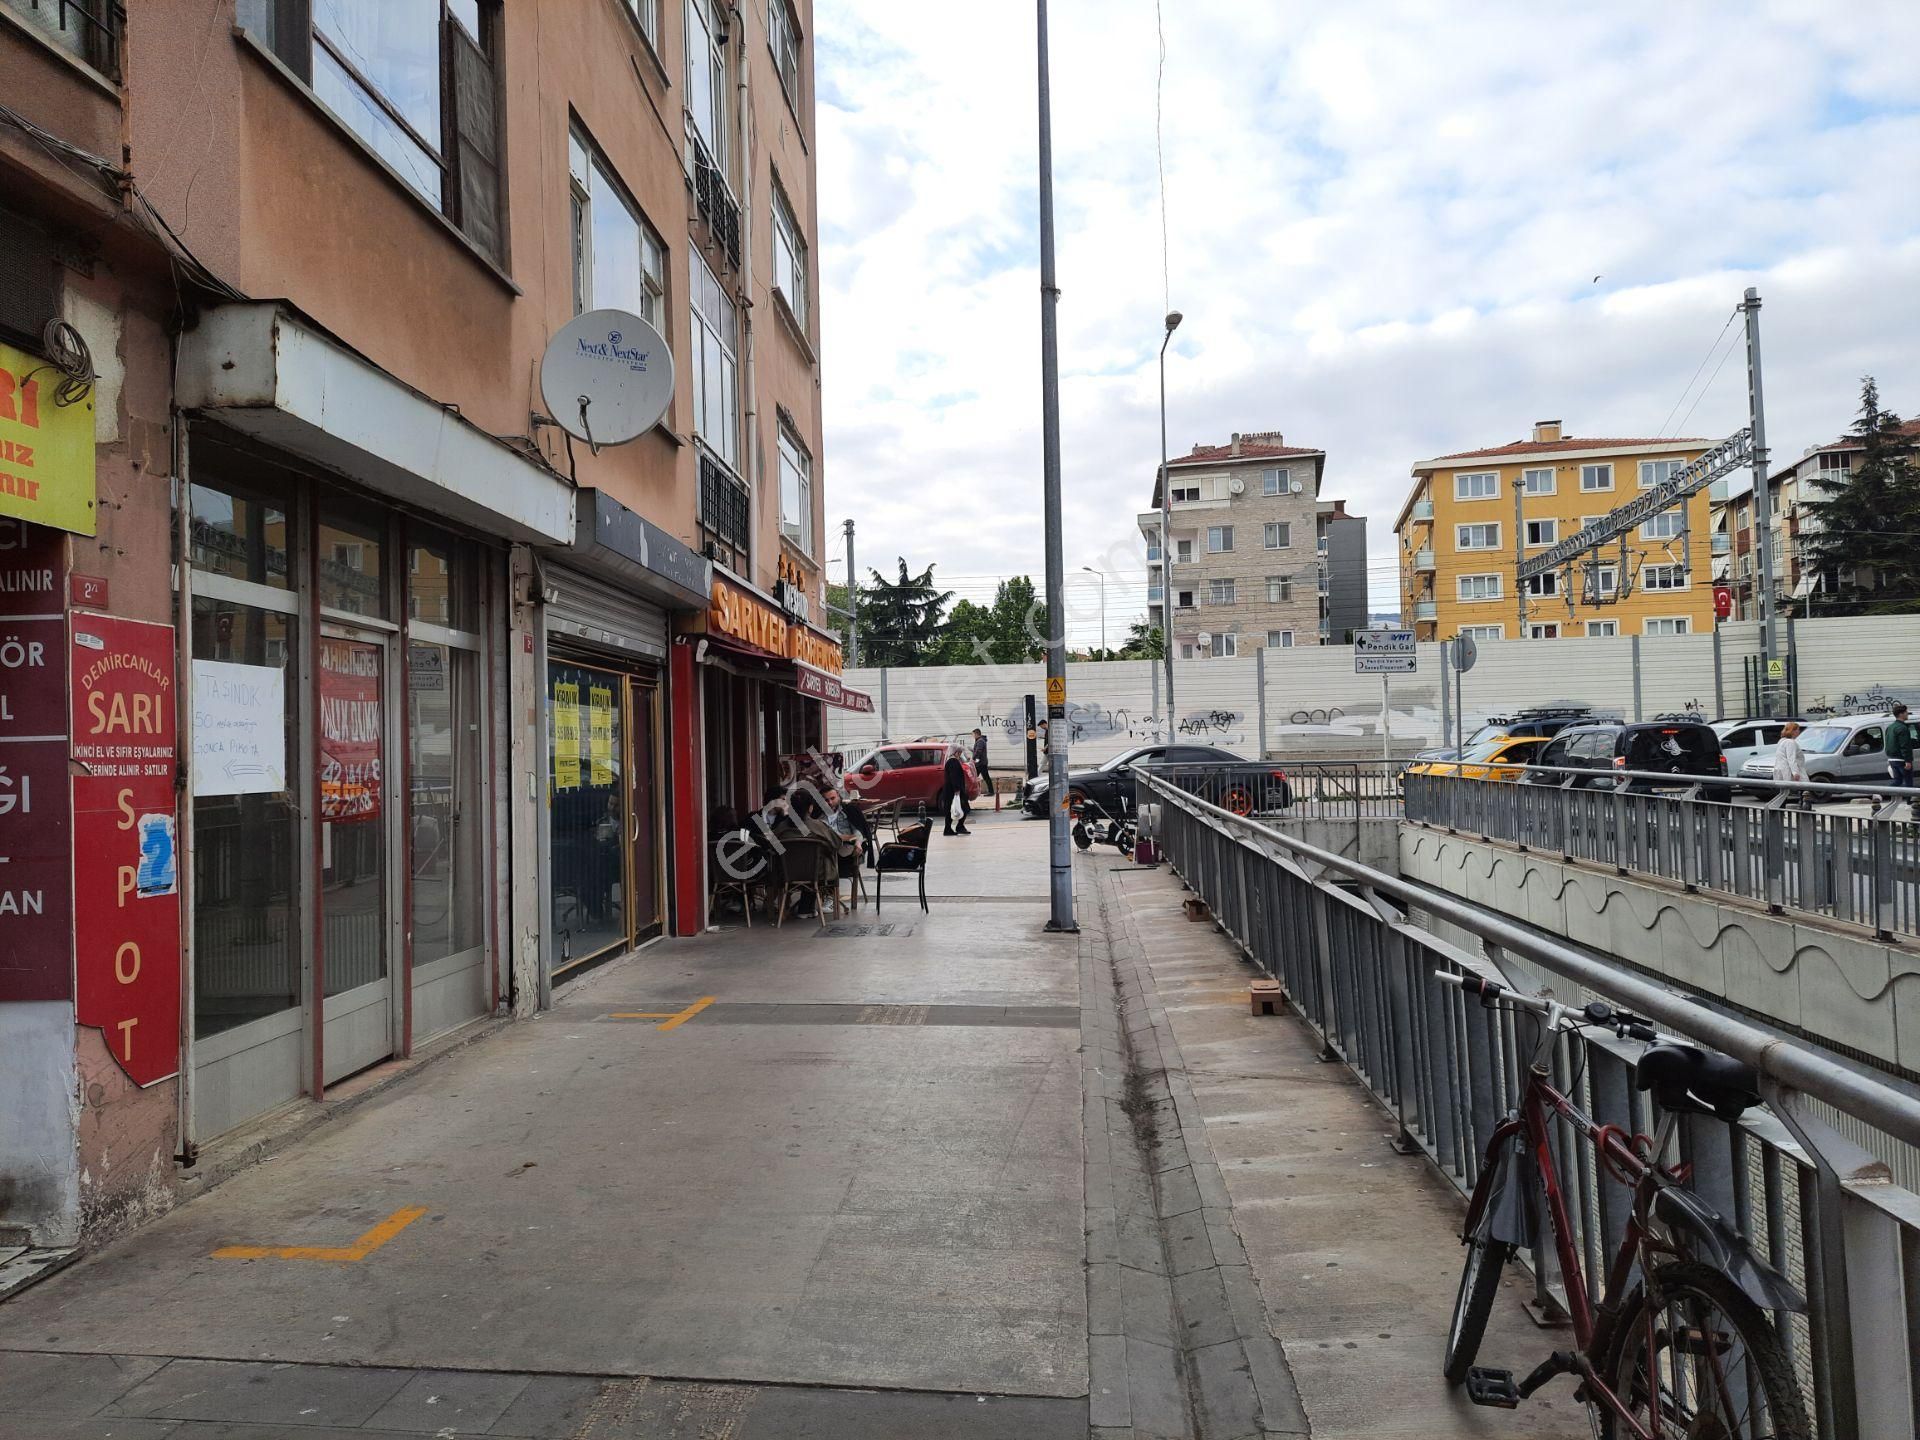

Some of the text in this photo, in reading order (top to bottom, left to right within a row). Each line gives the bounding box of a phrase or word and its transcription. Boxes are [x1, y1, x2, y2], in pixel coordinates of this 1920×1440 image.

[577, 338, 597, 357] Next
[710, 582, 788, 658] SARIYER
[1367, 642, 1414, 651] Pendik Gar
[81, 652, 170, 691] DEMİRCANLAR
[87, 690, 163, 735] SARI
[980, 715, 1018, 735] Miray
[74, 743, 174, 760] İKİNCİ EL VE SIFIR EŞYALARINIZ
[119, 764, 140, 776] ALINIR
[144, 764, 168, 776] SATILIR
[114, 788, 141, 1061] SPOT
